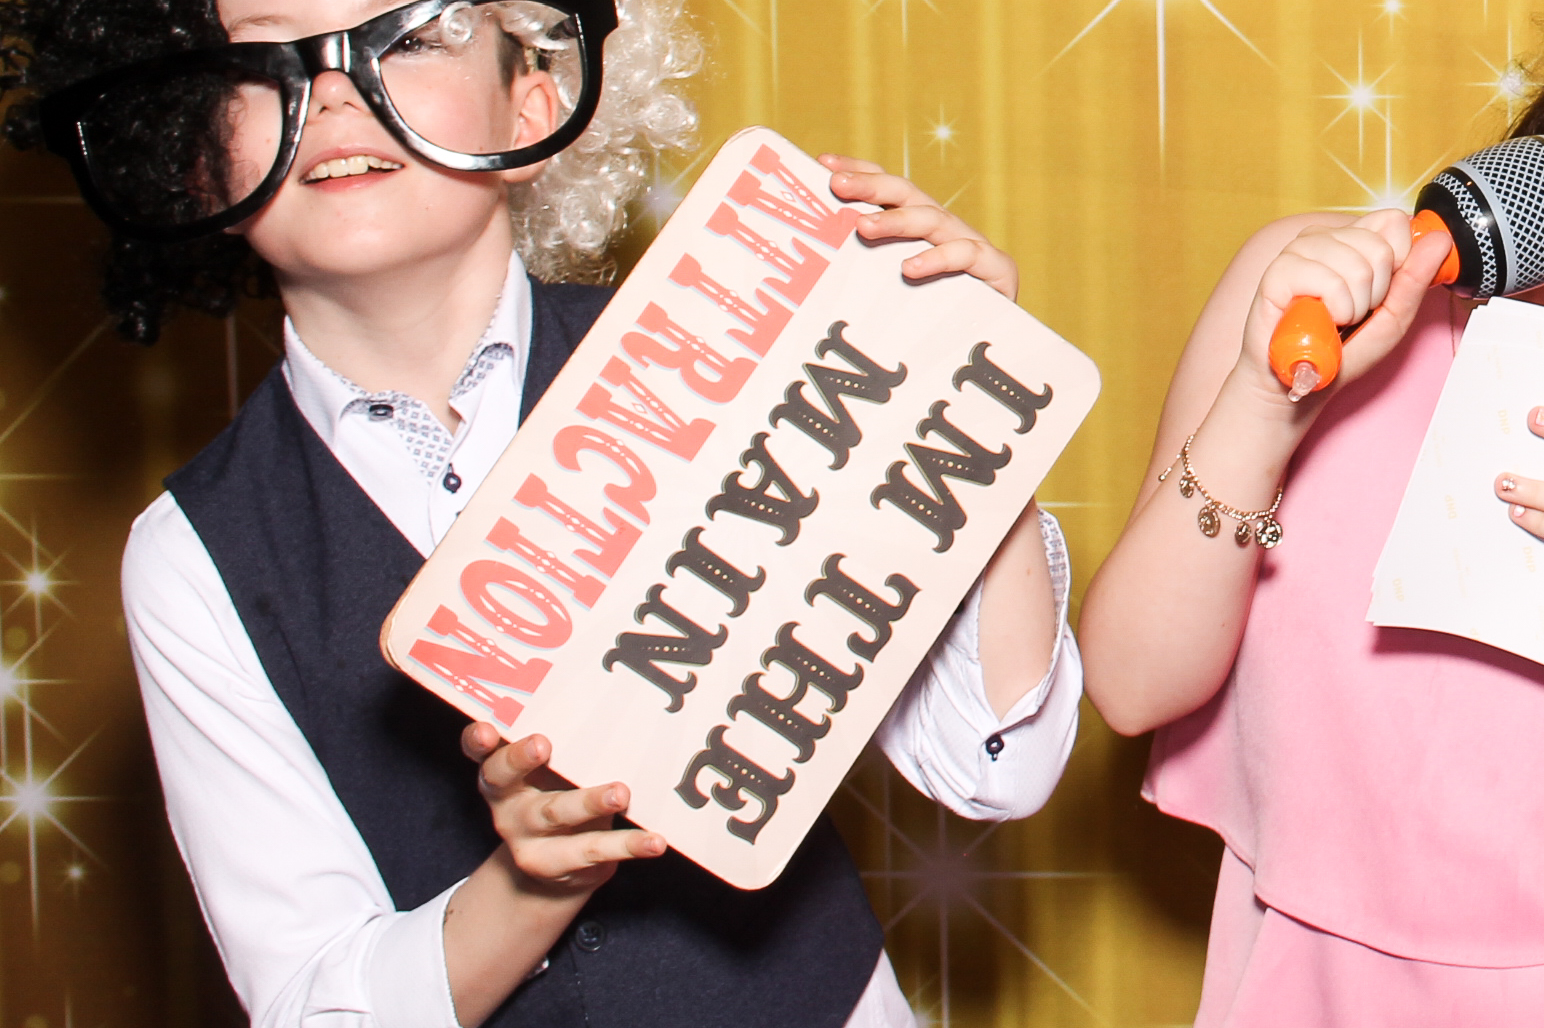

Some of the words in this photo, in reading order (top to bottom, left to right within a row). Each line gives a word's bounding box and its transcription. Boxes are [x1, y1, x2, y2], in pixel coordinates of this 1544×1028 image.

[407, 143, 860, 728] ATTRACTION
[602, 320, 908, 714] MAIN
[870, 341, 1054, 553] IM
[1444, 494, 1458, 520] DNP
[1497, 409, 1511, 435] DNP
[1522, 546, 1537, 573] DNP
[672, 553, 921, 847] THE
